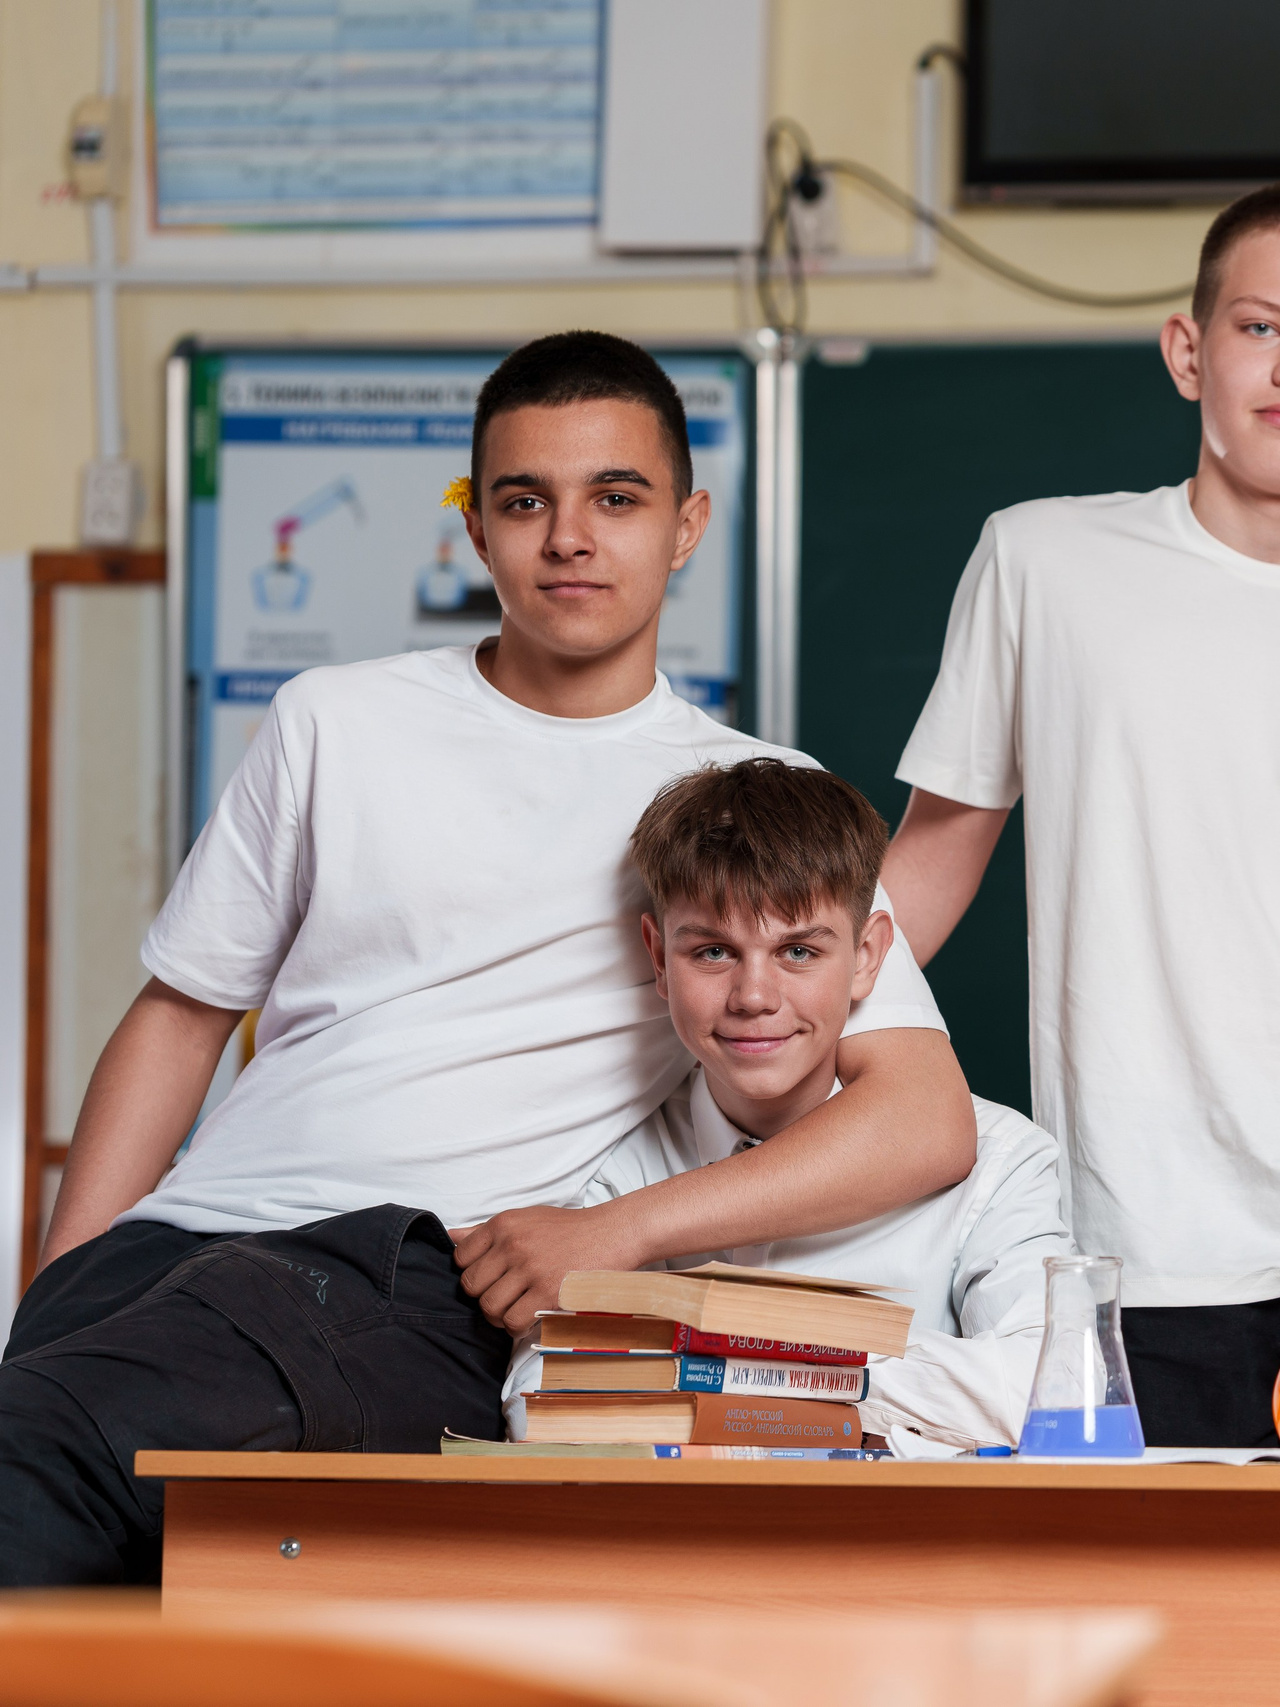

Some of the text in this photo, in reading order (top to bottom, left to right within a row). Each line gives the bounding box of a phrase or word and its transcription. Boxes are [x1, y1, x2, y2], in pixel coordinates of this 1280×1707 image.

[728, 1335, 774, 1350] СЛОВА
[730, 1366, 860, 1393] АНГЛИЙСКИЙ ЯЗЫК ЭКСПРЕСС-КУРС
[803, 1425, 834, 1436] СЛОВАРЬ
